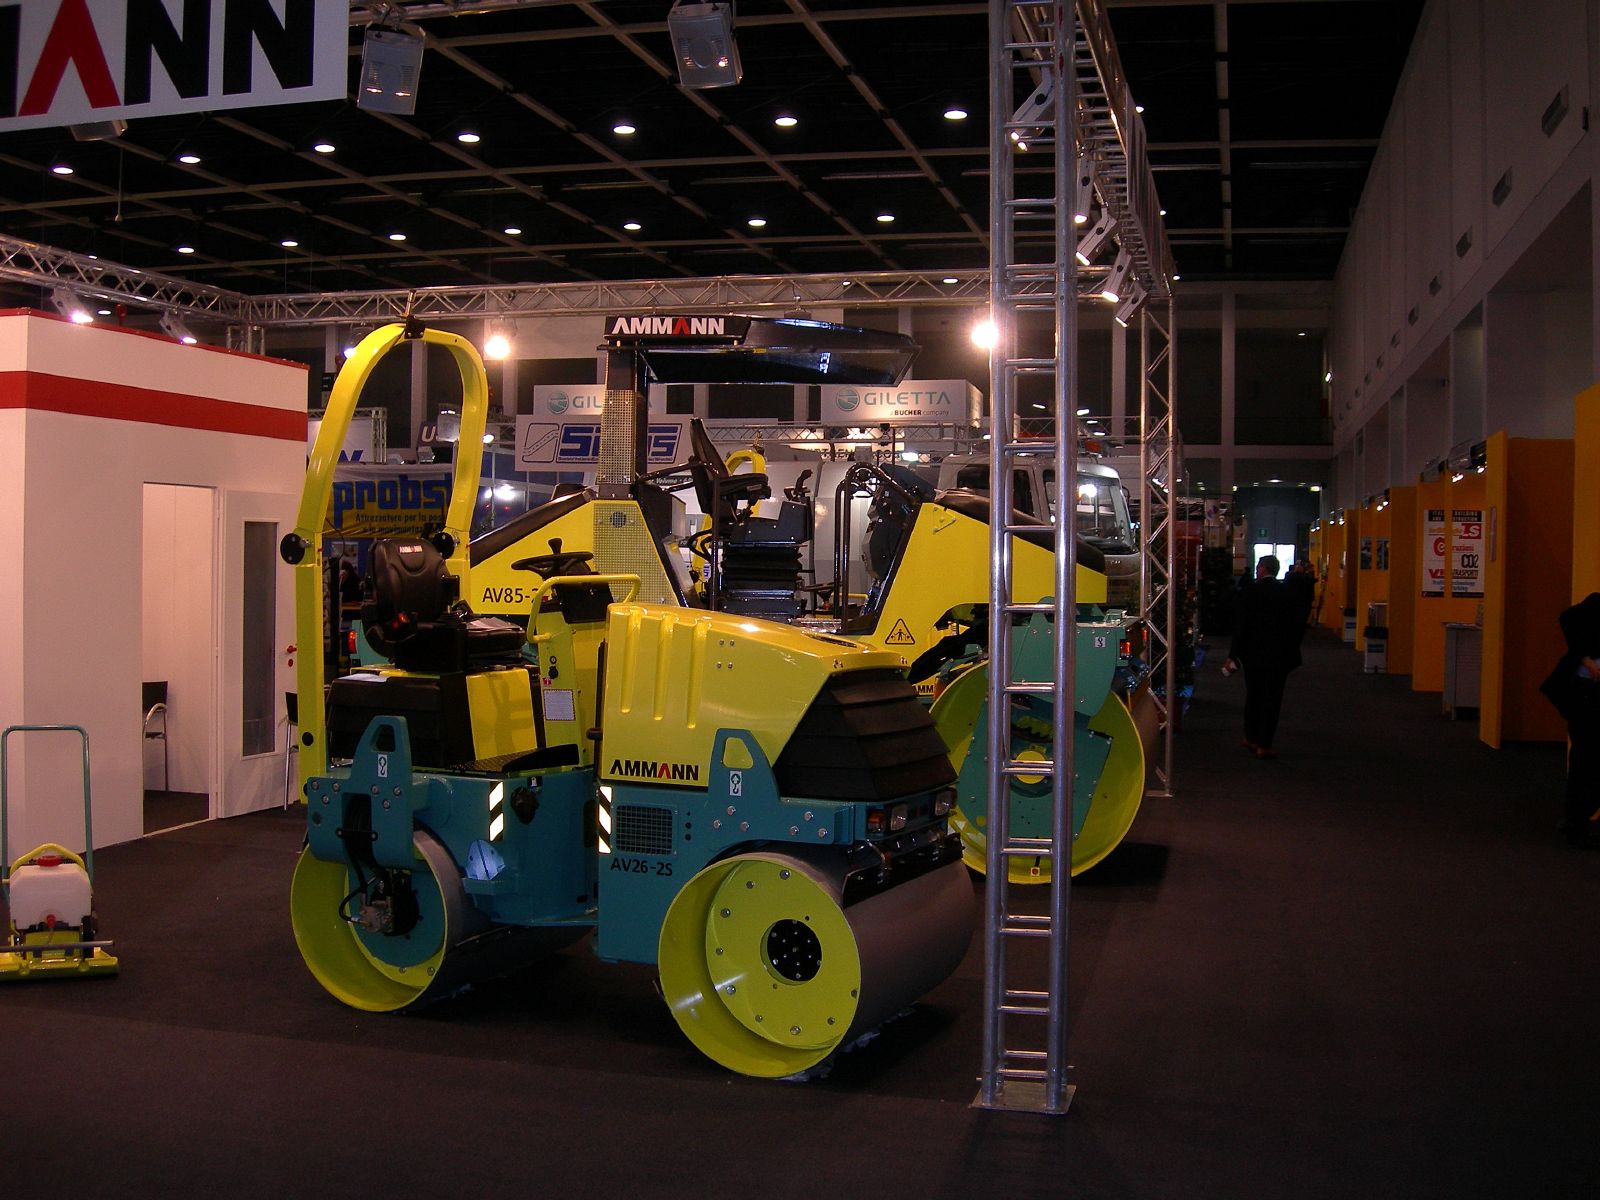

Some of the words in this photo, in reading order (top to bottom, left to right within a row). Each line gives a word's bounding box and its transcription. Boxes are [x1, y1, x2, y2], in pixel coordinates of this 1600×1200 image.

[0, 0, 315, 118] ANN
[611, 317, 725, 335] AMMANN
[864, 391, 950, 405] GILETTA
[923, 410, 949, 418] company
[609, 759, 699, 781] AMMANN
[610, 858, 673, 877] AV26-2S
